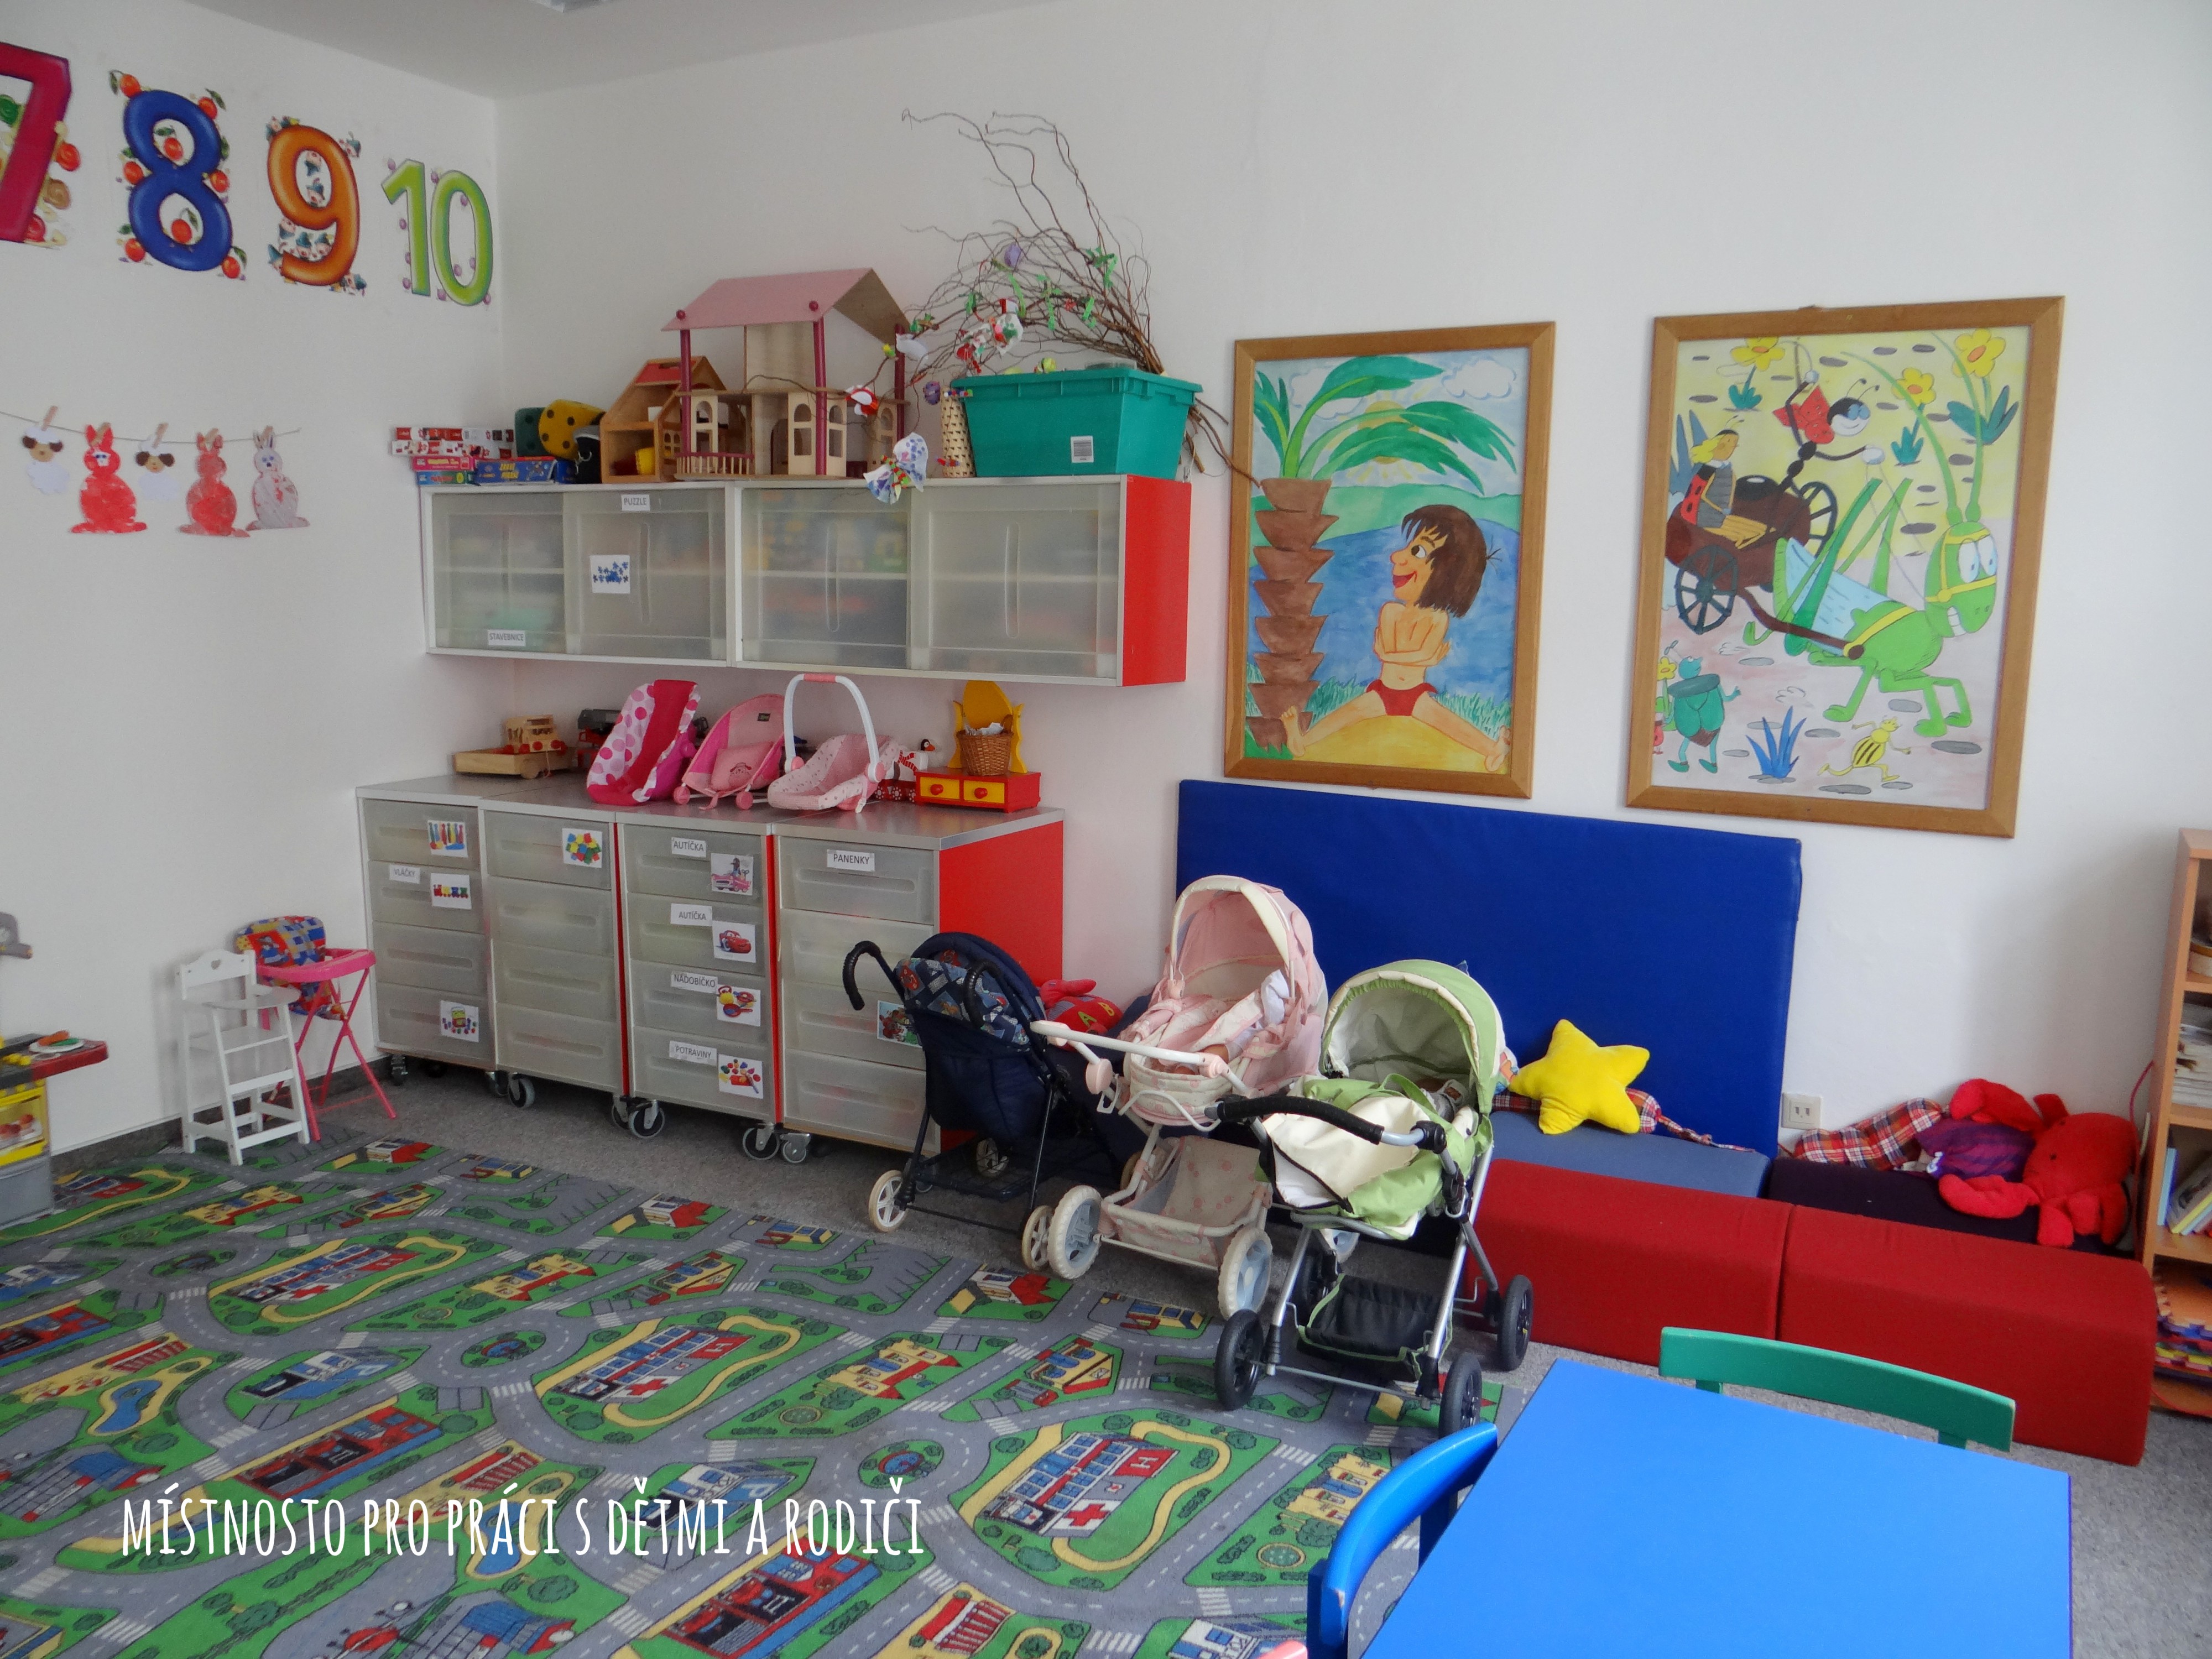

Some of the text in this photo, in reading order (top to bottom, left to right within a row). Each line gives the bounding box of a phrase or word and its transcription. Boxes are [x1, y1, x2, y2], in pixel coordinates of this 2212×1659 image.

[0, 42, 493, 306] 7 8 9 10
[624, 497, 647, 505] PUZZLE
[489, 633, 524, 641] STAVEBNICE
[674, 840, 704, 852] AUTÍČKA
[833, 853, 870, 864] PANENKY
[679, 910, 707, 920] AUTÍČKA
[674, 973, 716, 988] NÁDOBÍČKO
[1078, 1011, 1097, 1027] A
[676, 1045, 712, 1058] POTRAVINY
[1130, 1456, 1160, 1469] H
